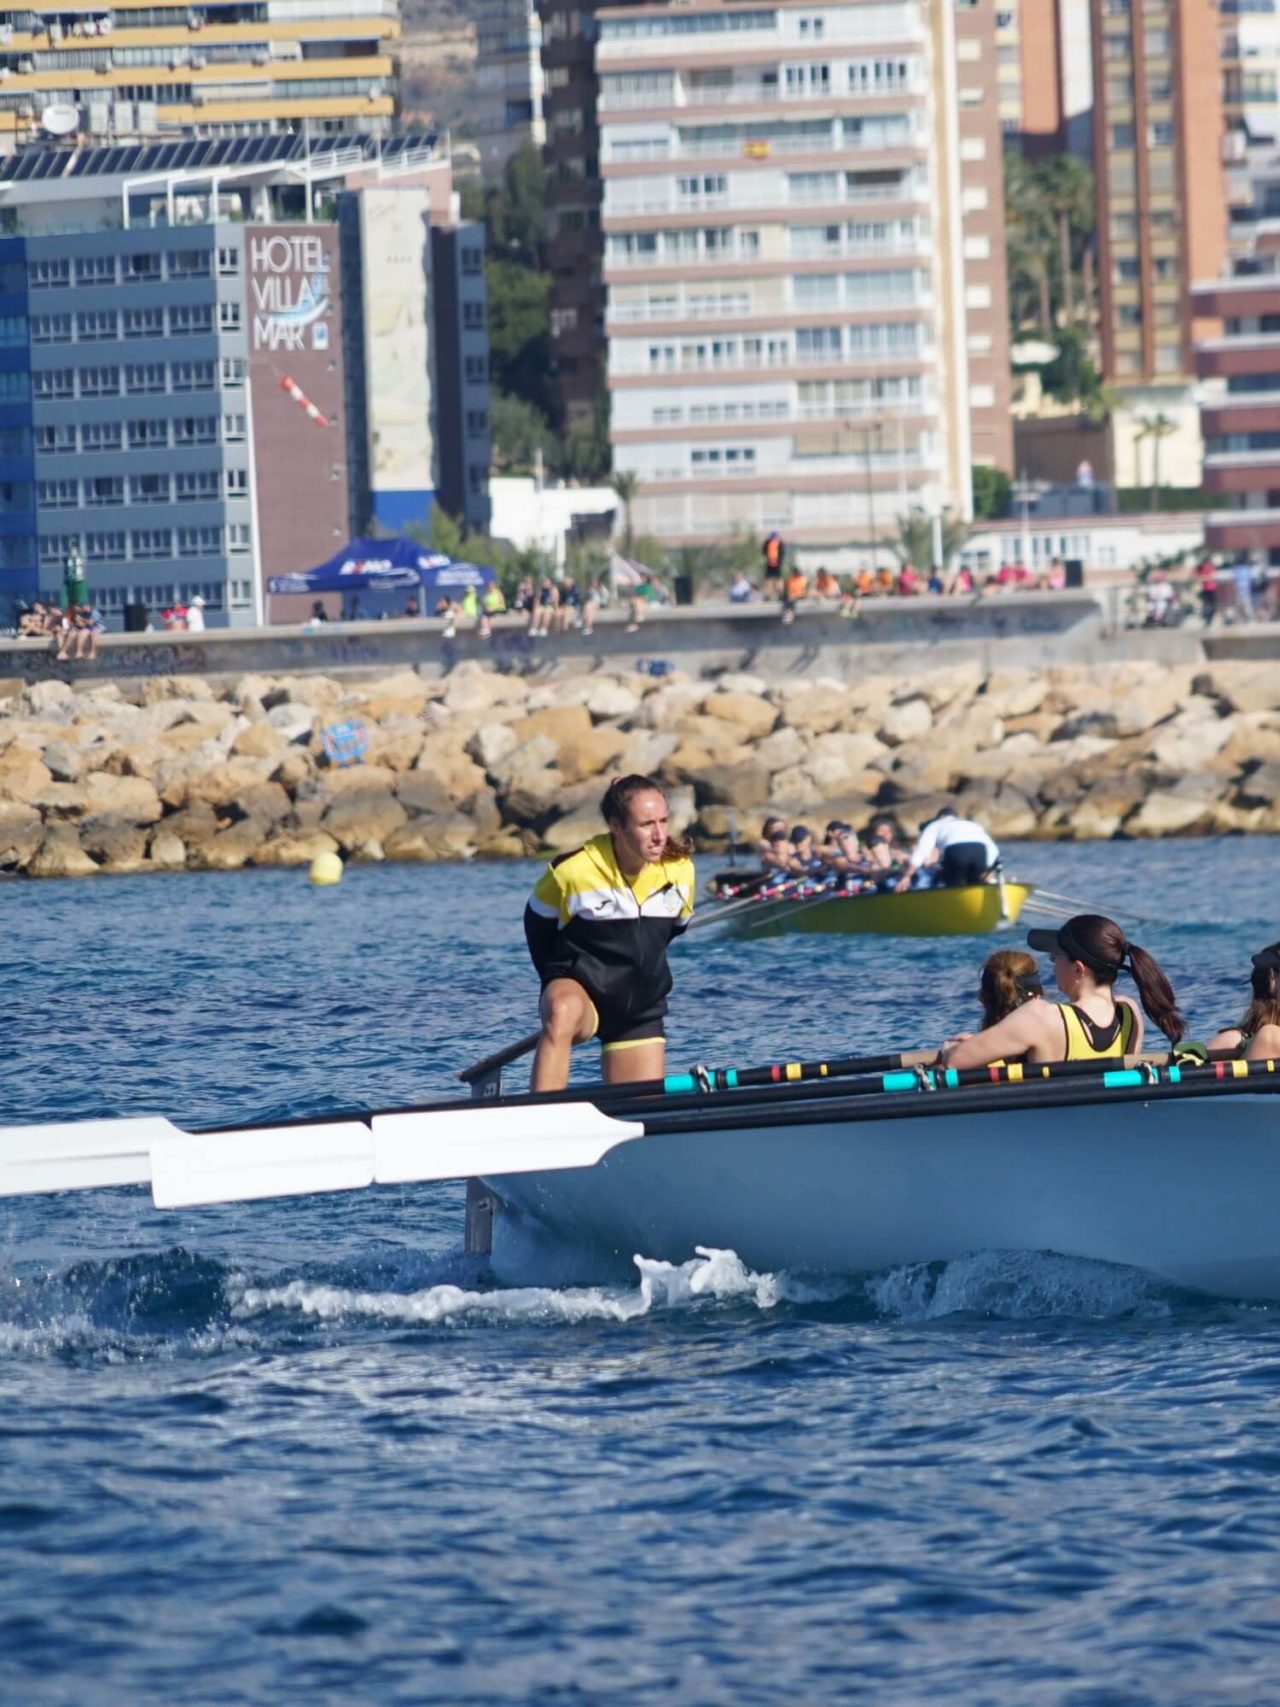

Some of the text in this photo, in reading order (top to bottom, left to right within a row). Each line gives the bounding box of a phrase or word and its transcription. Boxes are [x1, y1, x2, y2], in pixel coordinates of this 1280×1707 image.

[251, 236, 331, 273] HOTEL
[251, 275, 315, 311] VILLA
[254, 314, 305, 350] MAR
